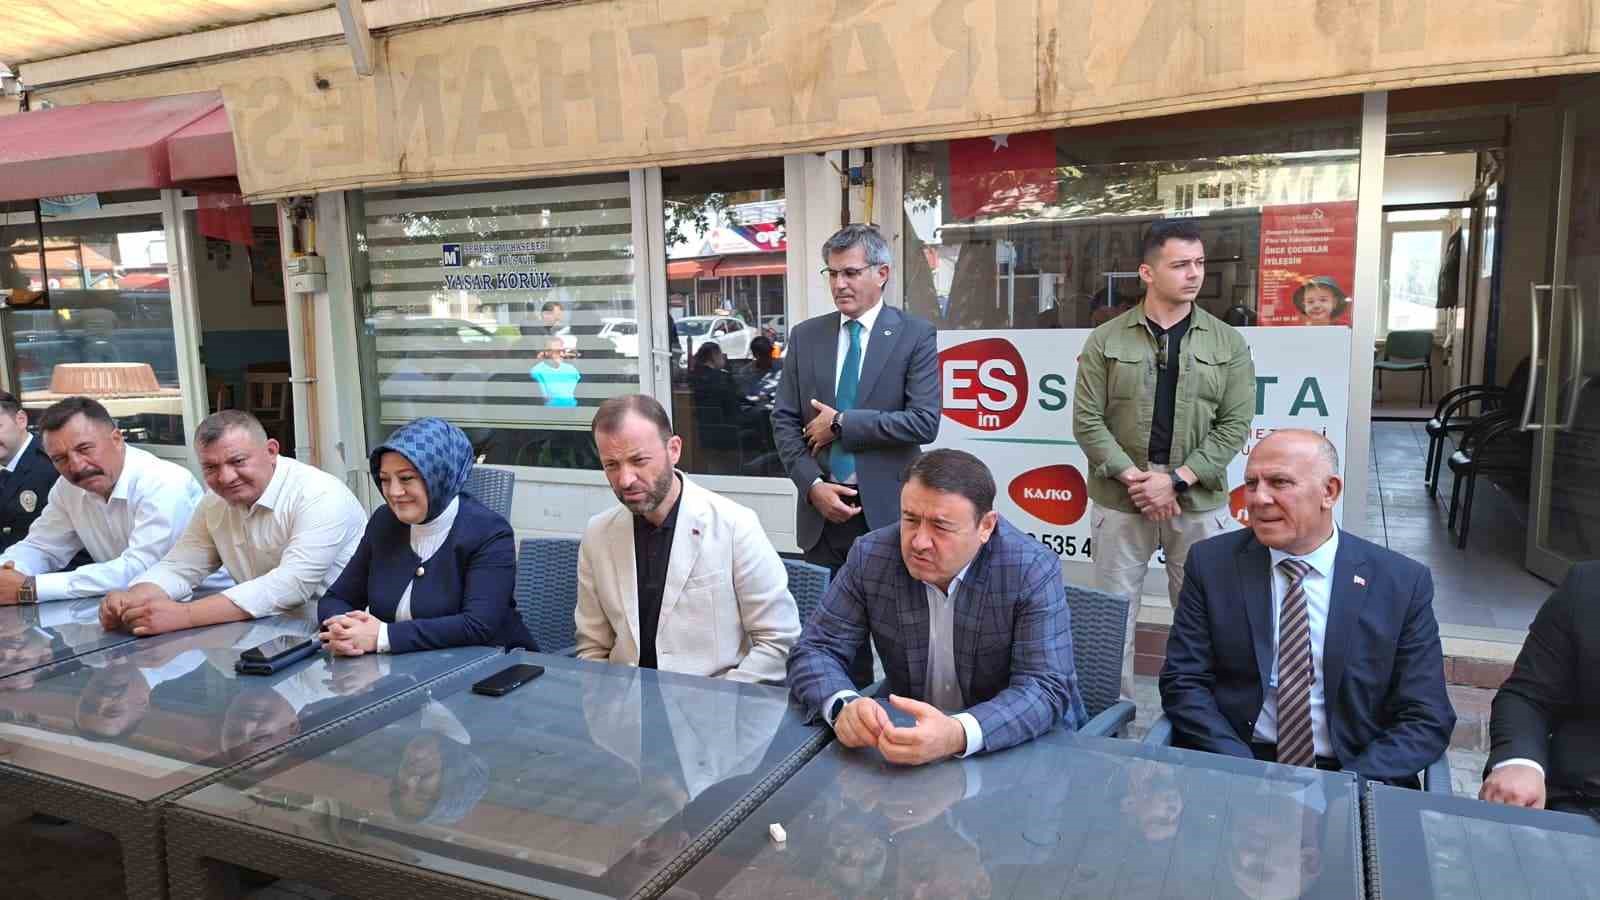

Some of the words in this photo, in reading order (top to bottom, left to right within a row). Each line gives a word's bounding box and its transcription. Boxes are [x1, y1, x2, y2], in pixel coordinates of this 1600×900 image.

[943, 359, 1018, 411] ES
[978, 412, 1000, 427] im
[1024, 487, 1073, 501] KASKO
